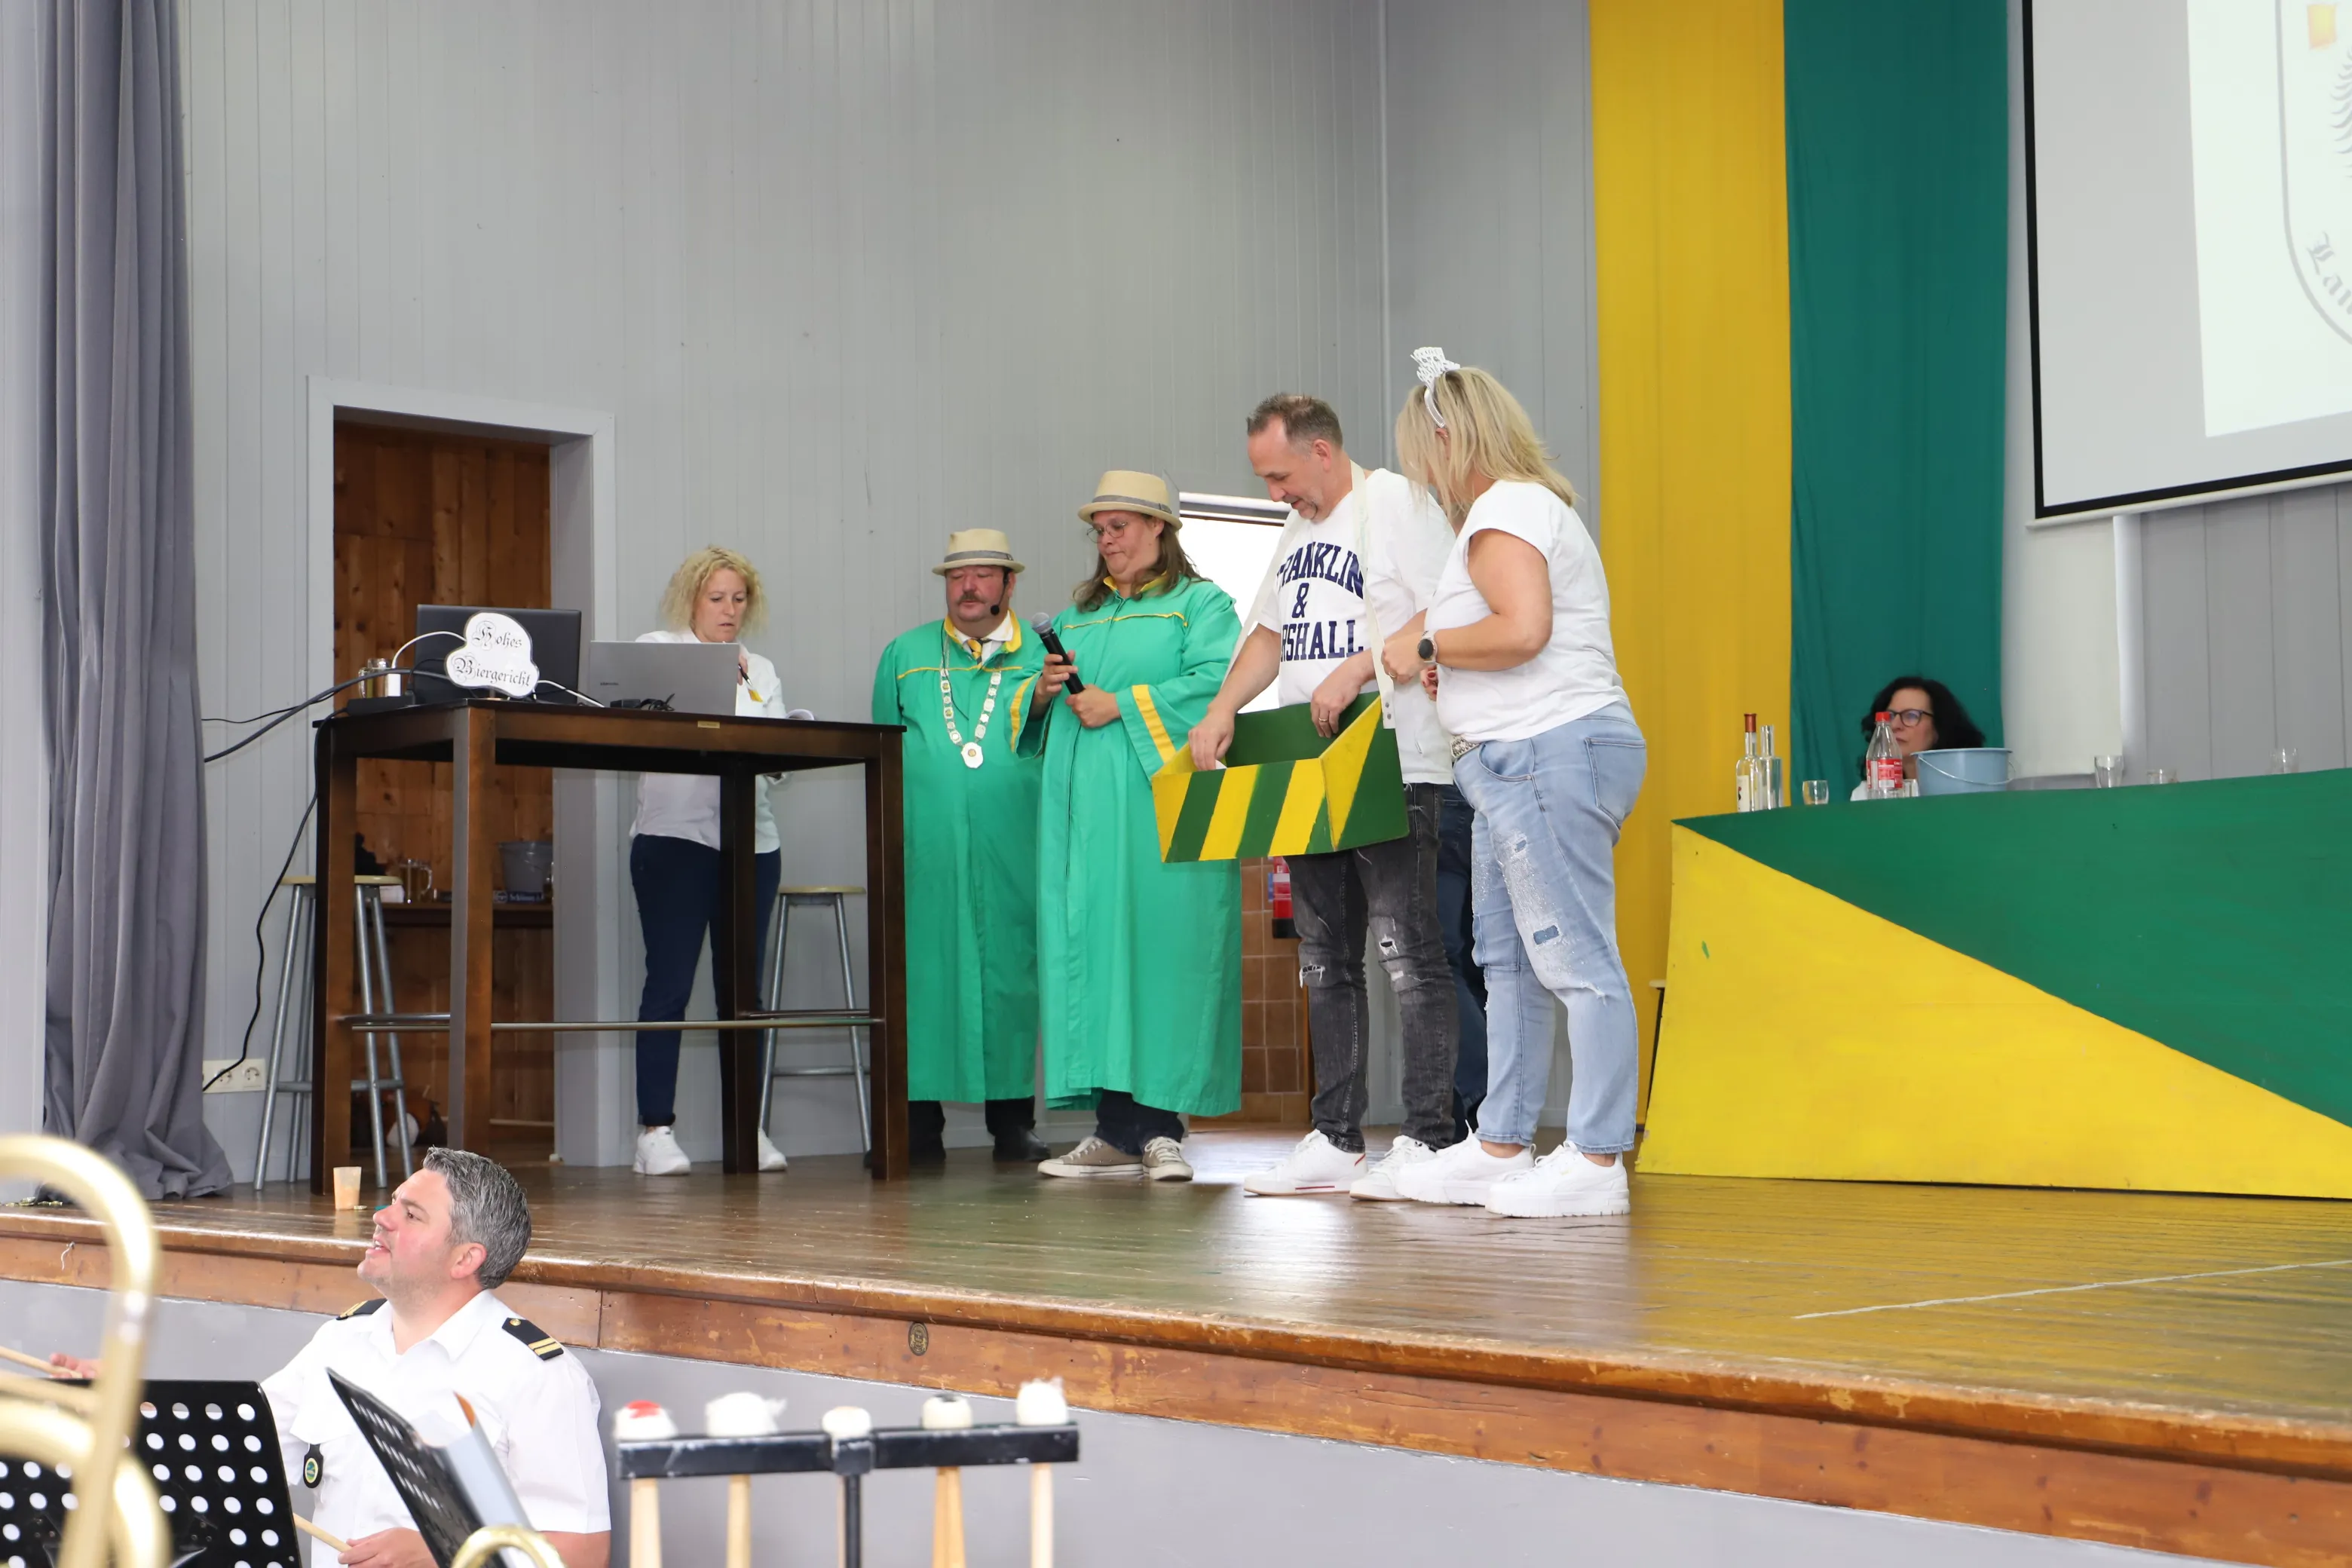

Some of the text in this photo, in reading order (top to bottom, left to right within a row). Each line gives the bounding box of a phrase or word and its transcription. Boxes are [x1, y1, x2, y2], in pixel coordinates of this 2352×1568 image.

[1291, 582, 1310, 619] &
[472, 621, 522, 651] Hohes
[1281, 620, 1364, 662] RSHALL
[453, 653, 531, 687] Biergericht
